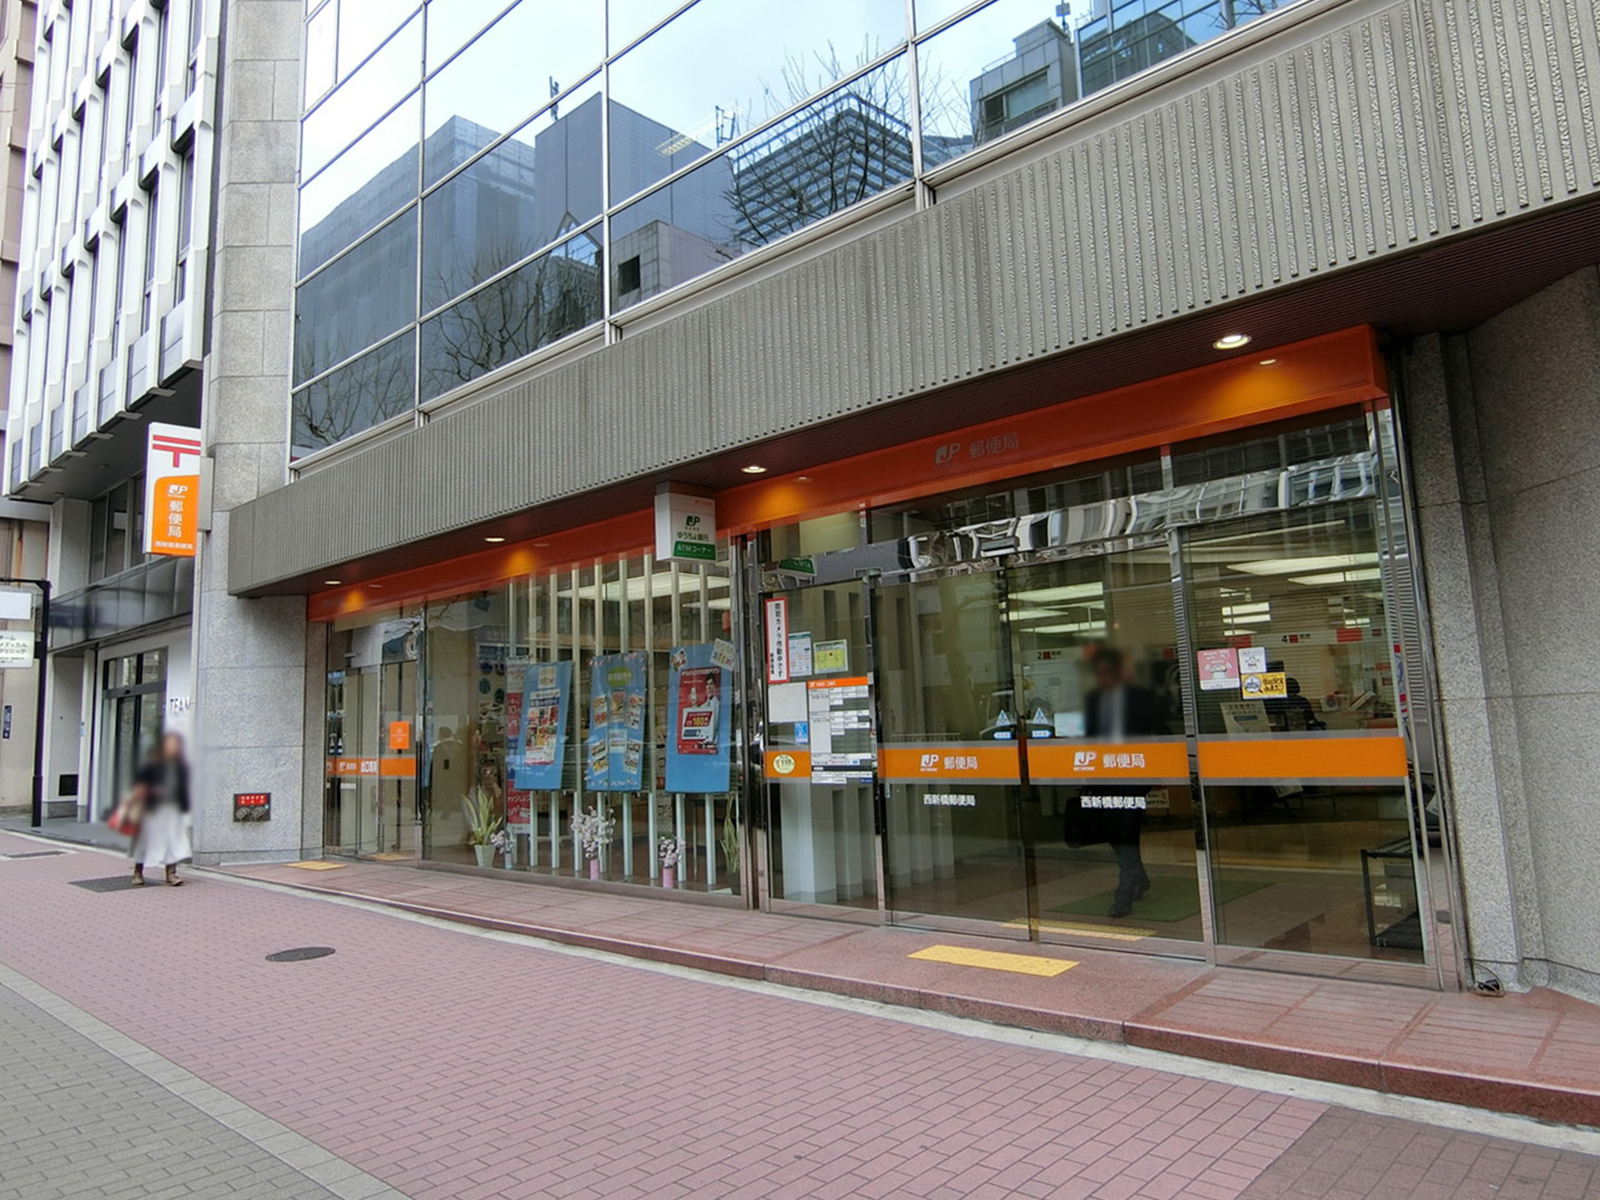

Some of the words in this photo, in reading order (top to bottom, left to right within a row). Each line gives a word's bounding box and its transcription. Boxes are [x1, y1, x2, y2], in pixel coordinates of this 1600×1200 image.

[969, 432, 1019, 459] 郵便局
[168, 500, 183, 538] 郵便局
[686, 515, 700, 527] JP
[677, 531, 709, 542] ゆうちょ銀行
[677, 543, 711, 554] ATMコーナー
[921, 754, 939, 767] JP
[944, 756, 978, 770] 郵便局
[1074, 751, 1096, 766] JP
[1103, 753, 1146, 768] 郵便局
[923, 793, 976, 806] 西新橋郵便局
[1080, 795, 1147, 809] 西新橋郵便局
